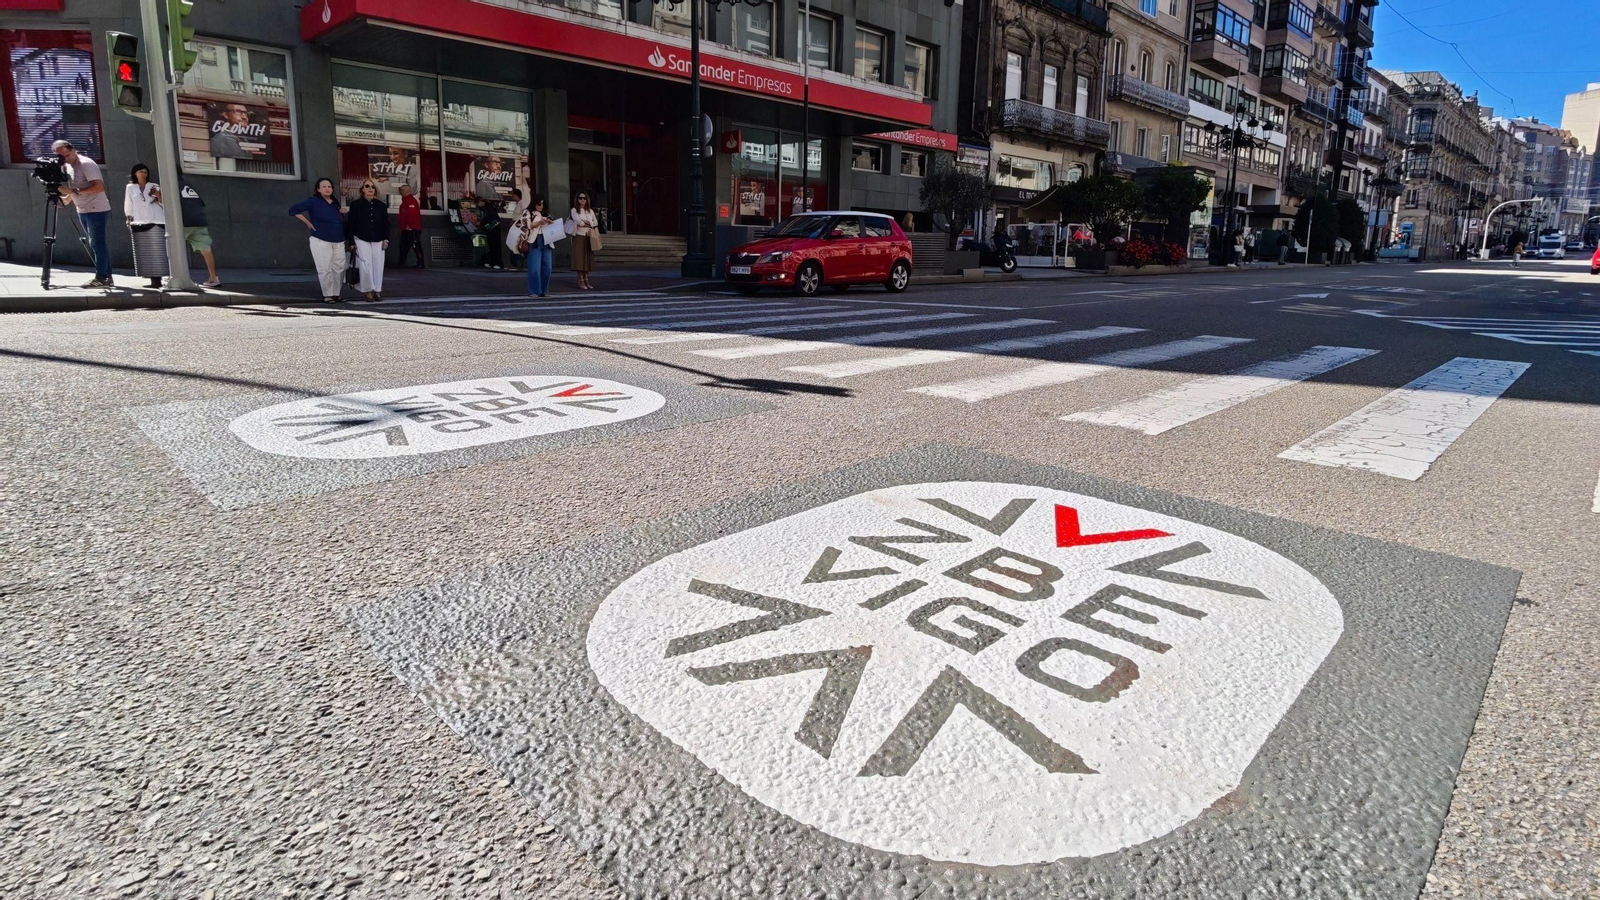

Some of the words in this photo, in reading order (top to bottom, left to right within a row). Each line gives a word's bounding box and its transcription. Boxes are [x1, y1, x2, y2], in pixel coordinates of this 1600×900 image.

[669, 54, 735, 82] Sanander
[738, 69, 792, 95] Empresas
[212, 120, 266, 136] GROWTH
[372, 161, 412, 175] START
[477, 169, 513, 182] GROWTH
[848, 517, 1208, 654] ZBE
[801, 545, 1140, 704] VIGO
